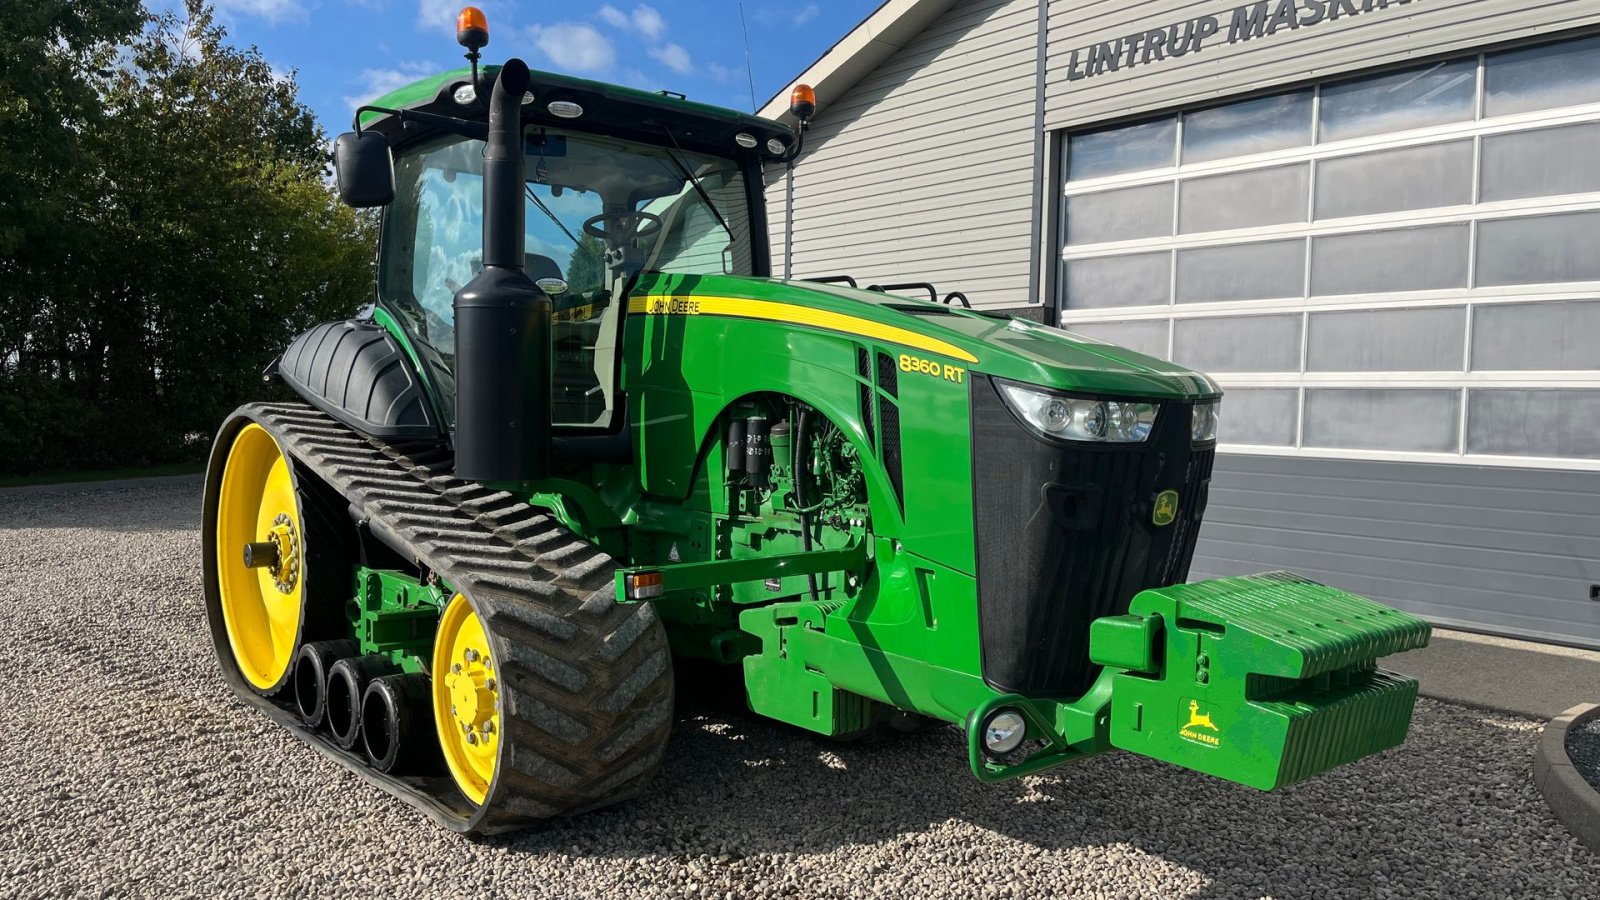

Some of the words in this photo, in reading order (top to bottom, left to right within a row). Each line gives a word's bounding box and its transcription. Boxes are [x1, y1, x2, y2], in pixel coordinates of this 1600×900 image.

[1067, 15, 1219, 81] LINTRUP
[1227, 0, 1411, 44] MASK
[648, 298, 671, 313] JOHN
[671, 298, 700, 313] DEERE
[899, 354, 941, 377] 8360
[943, 364, 965, 384] RT
[1179, 729, 1198, 740] JOHN
[1197, 733, 1220, 746] DEERE
